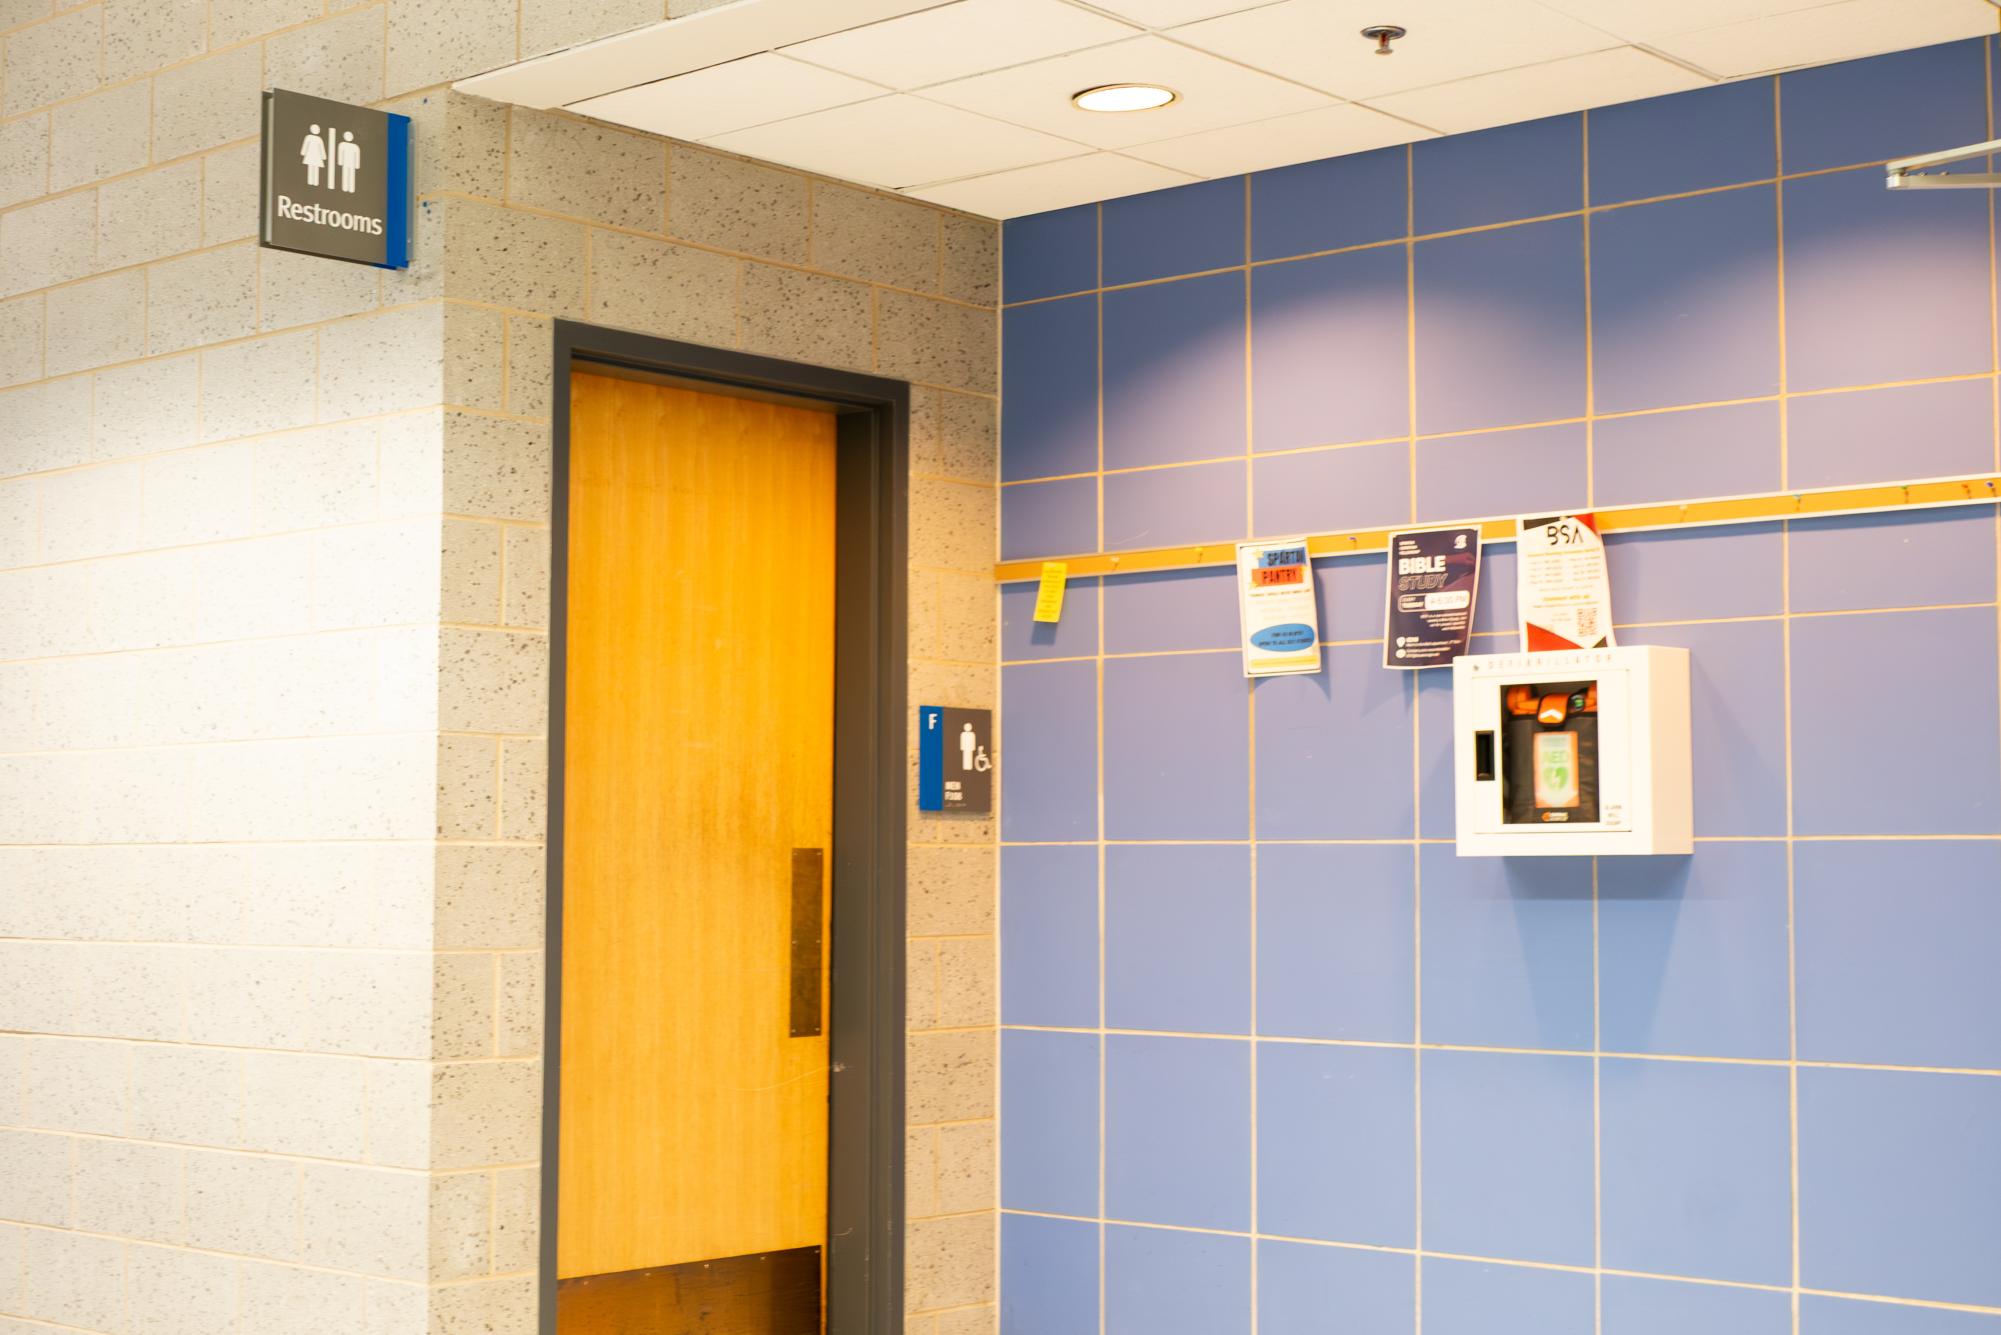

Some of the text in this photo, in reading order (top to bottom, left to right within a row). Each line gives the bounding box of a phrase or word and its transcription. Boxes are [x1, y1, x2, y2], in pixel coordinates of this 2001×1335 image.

[277, 195, 383, 236] Restrooms
[1547, 525, 1584, 545] BSA
[1399, 555, 1446, 575] BIBLE
[1263, 569, 1296, 583] PANTRY
[1399, 573, 1448, 591] STUDY
[928, 713, 938, 730] F
